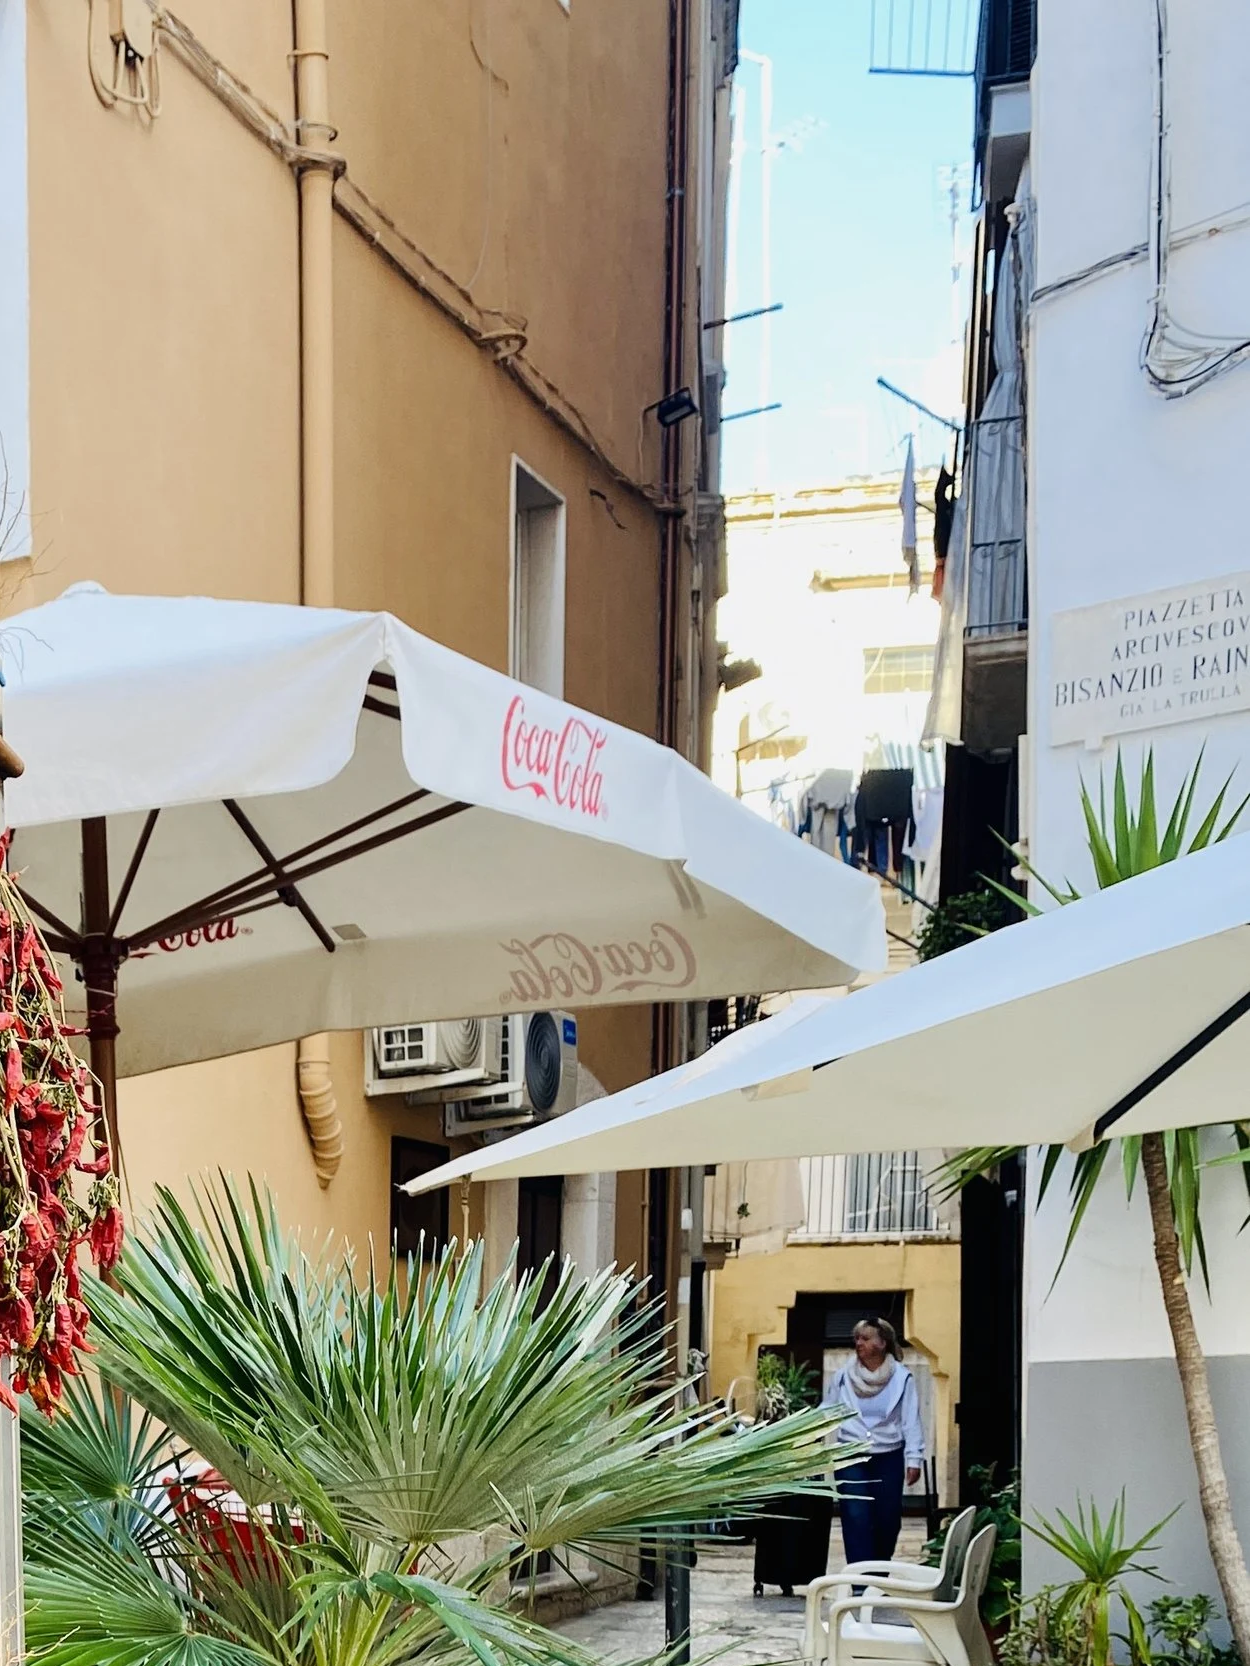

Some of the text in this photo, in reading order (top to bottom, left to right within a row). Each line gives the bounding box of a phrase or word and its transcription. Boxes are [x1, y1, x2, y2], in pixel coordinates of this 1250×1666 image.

[1124, 589, 1244, 631] PIAZZETTA
[1055, 662, 1163, 707] BISANZIO
[502, 695, 607, 816] Coca-Cola
